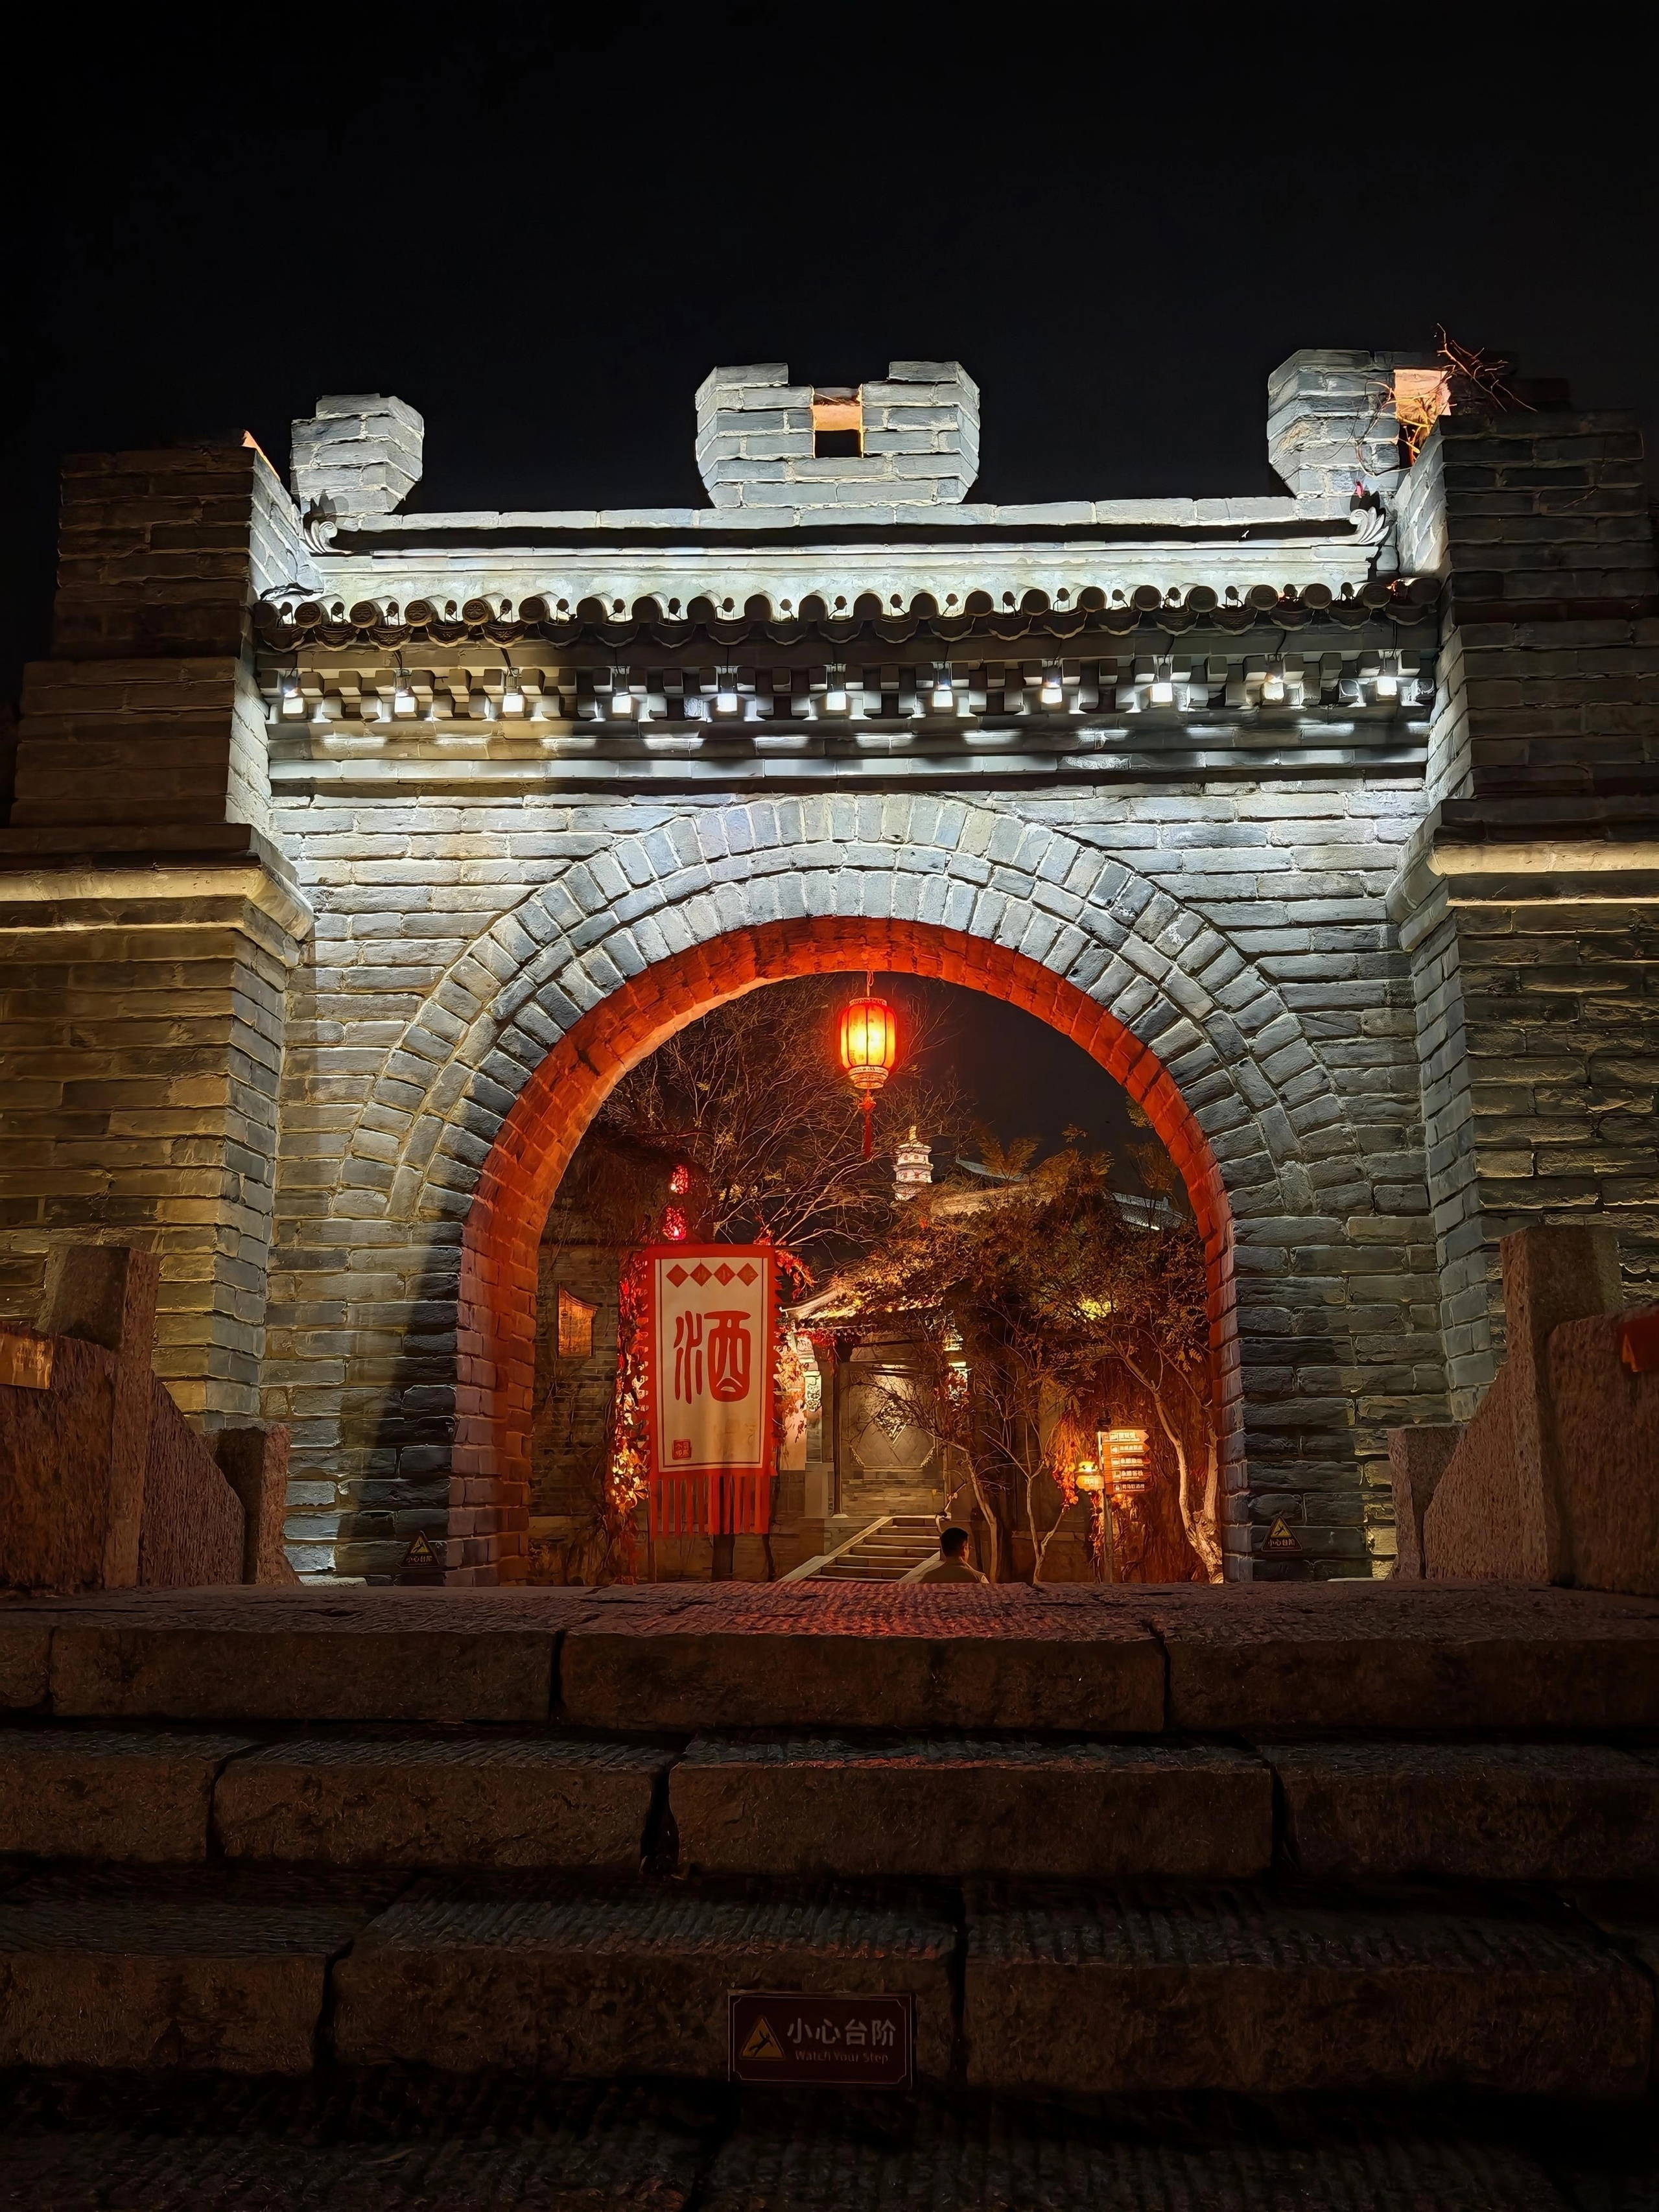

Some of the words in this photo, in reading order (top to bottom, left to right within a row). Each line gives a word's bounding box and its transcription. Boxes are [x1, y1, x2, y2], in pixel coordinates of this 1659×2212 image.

[674, 1310, 751, 1404] 酒
[786, 2017, 896, 2047] 小心台阶
[795, 2050, 830, 2062] Watch
[834, 2051, 859, 2062] Your
[862, 2052, 889, 2065] Step
